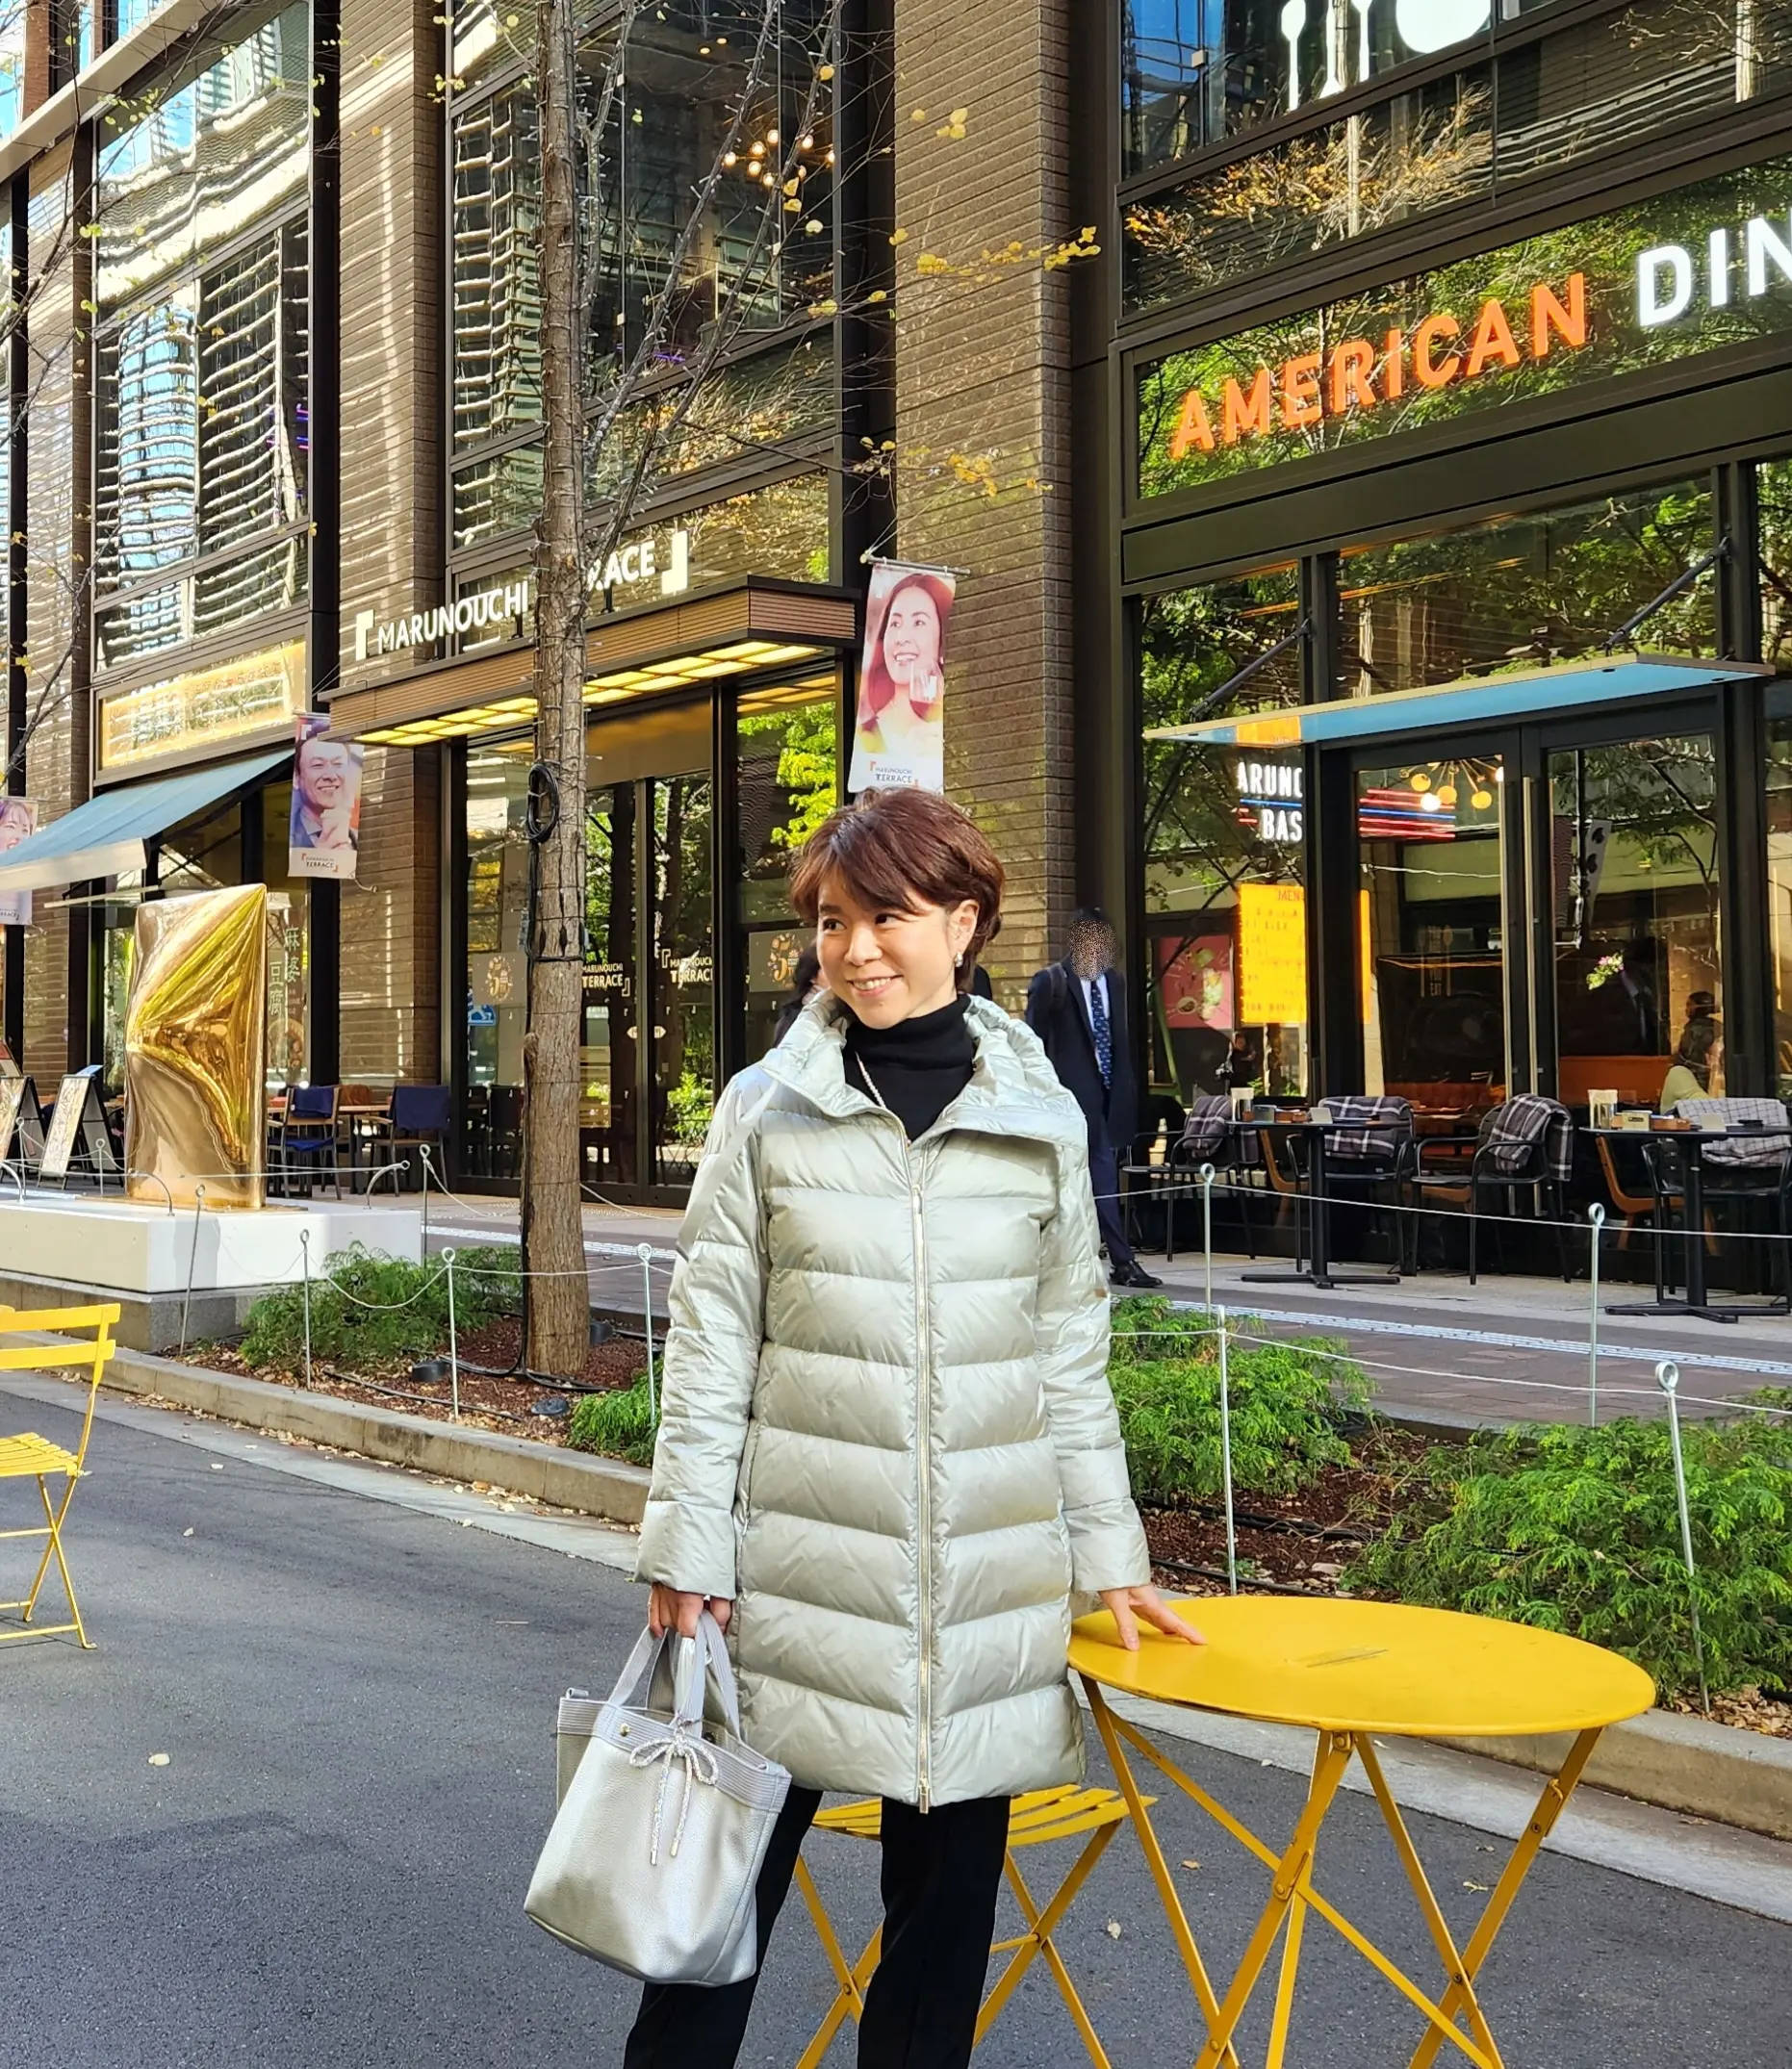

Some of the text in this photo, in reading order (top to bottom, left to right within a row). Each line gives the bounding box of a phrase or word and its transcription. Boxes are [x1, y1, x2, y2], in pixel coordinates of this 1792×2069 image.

[1171, 272, 1588, 460] AMERICAN
[377, 540, 656, 655] MARUNOUCHI RACE
[876, 773, 912, 783] TERRACE
[1278, 889, 1304, 902] MEN
[285, 927, 301, 983] 麻婆
[581, 973, 624, 989] TERRACE
[269, 961, 284, 1016] 豆腐
